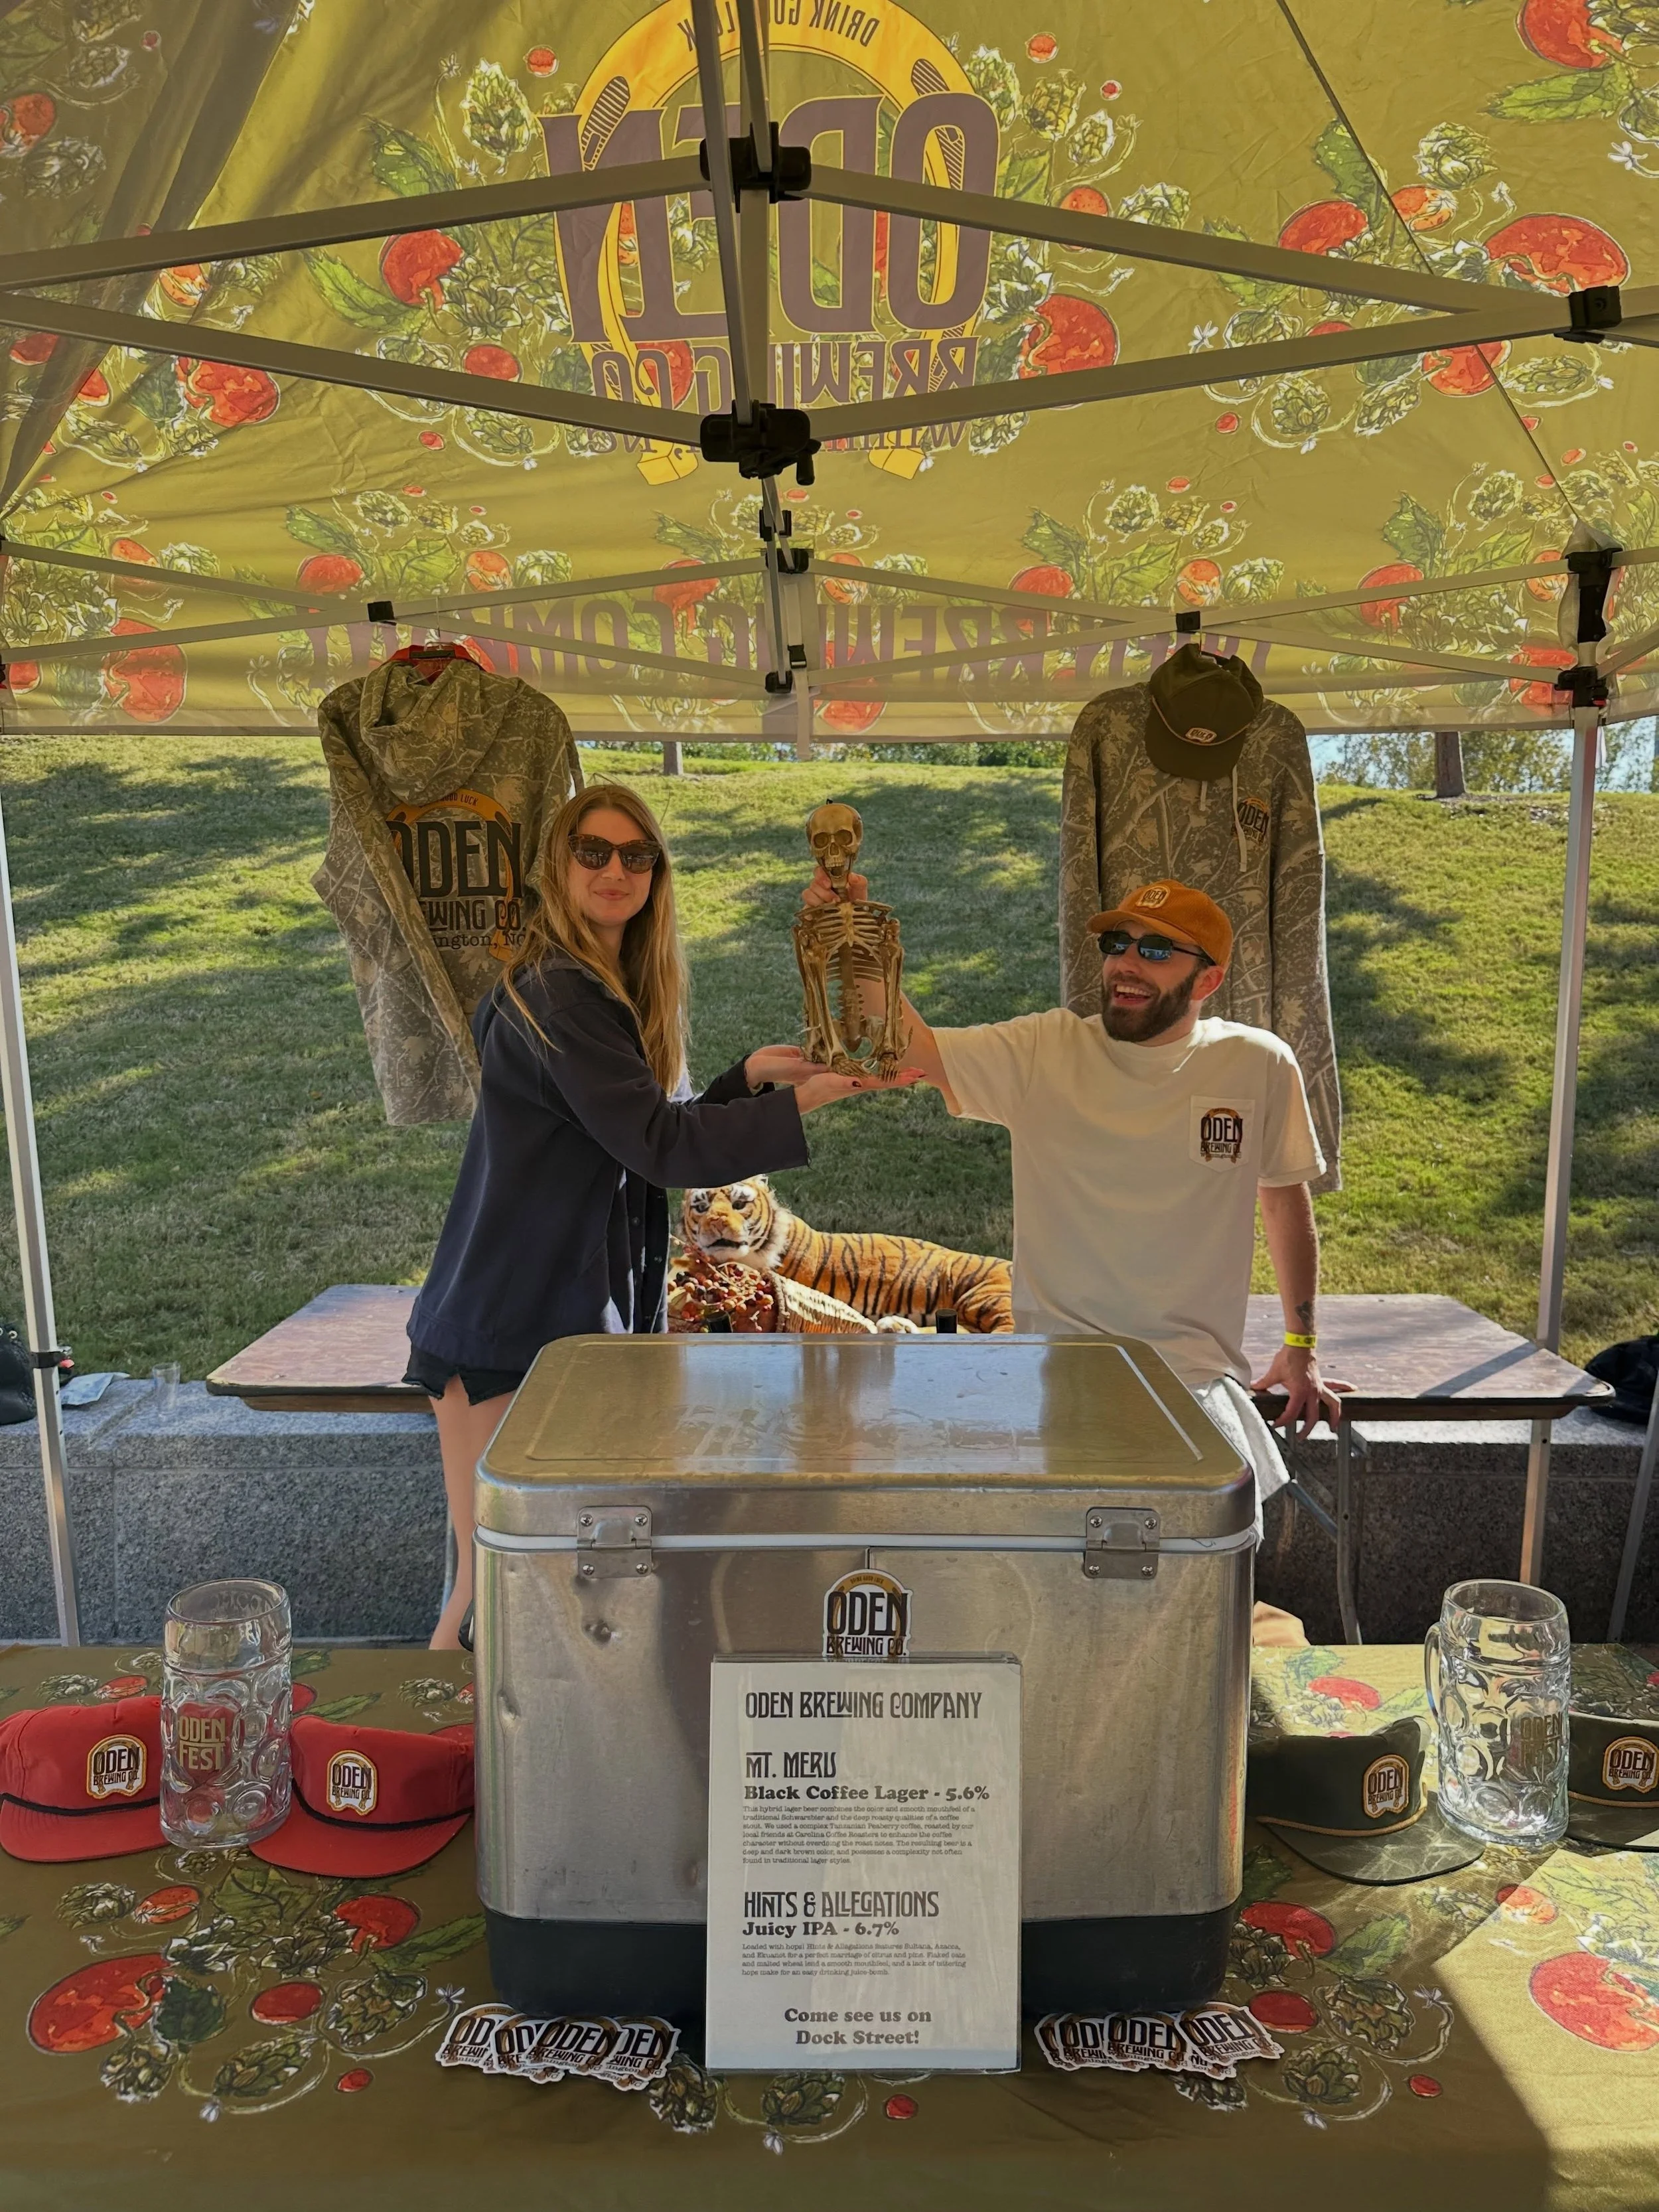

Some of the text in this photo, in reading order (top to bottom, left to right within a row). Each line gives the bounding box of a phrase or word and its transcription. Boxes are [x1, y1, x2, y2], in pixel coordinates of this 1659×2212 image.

[419, 901, 486, 930] WING
[433, 934, 498, 950] ington,
[1200, 1116, 1242, 1143] ODEN
[827, 1590, 908, 1637] ODEN
[827, 1637, 906, 1656] BREWING CO.
[746, 1692, 983, 1718] ODEN BREWING COMPANY
[179, 1716, 226, 1743] ODEN
[94, 1747, 140, 1775] ODEN
[179, 1739, 226, 1770] FEST
[746, 1752, 776, 1778] MT.
[1609, 1749, 1655, 1771] ODEN
[94, 1771, 126, 1785] BREWING
[332, 1763, 372, 1790] ODEN
[1368, 1767, 1403, 1795] ODEN
[1609, 1769, 1640, 1779] BREWING
[332, 1785, 360, 1800] BREWING
[744, 1785, 800, 1800] Black
[806, 1785, 869, 1800] Coffee
[874, 1786, 929, 1803] Lager
[946, 1787, 991, 1801] 5.6%
[744, 1891, 940, 1917] HINTS & ALLEGATIONS
[742, 1922, 796, 1938] Juicy
[802, 1922, 837, 1935] IPA
[854, 1922, 900, 1937] 6.7%
[784, 2008, 932, 2022] Come see us on
[1181, 2009, 1265, 2047] ODEN
[449, 2015, 496, 2046] OD
[494, 2025, 545, 2055] OD
[537, 2022, 623, 2057] ODEN
[796, 2030, 920, 2045] Dock Street!
[1059, 2020, 1104, 2049] OD
[1108, 2016, 1187, 2053] ODEN
[442, 2044, 490, 2058] BREWI
[529, 2047, 585, 2063] BREWING
[615, 2028, 676, 2060] DEN
[1062, 2046, 1104, 2059] BREWI
[1108, 2041, 1164, 2059] BREWING
[1198, 2037, 1256, 2057] BREWING
[604, 2055, 643, 2068] WING
